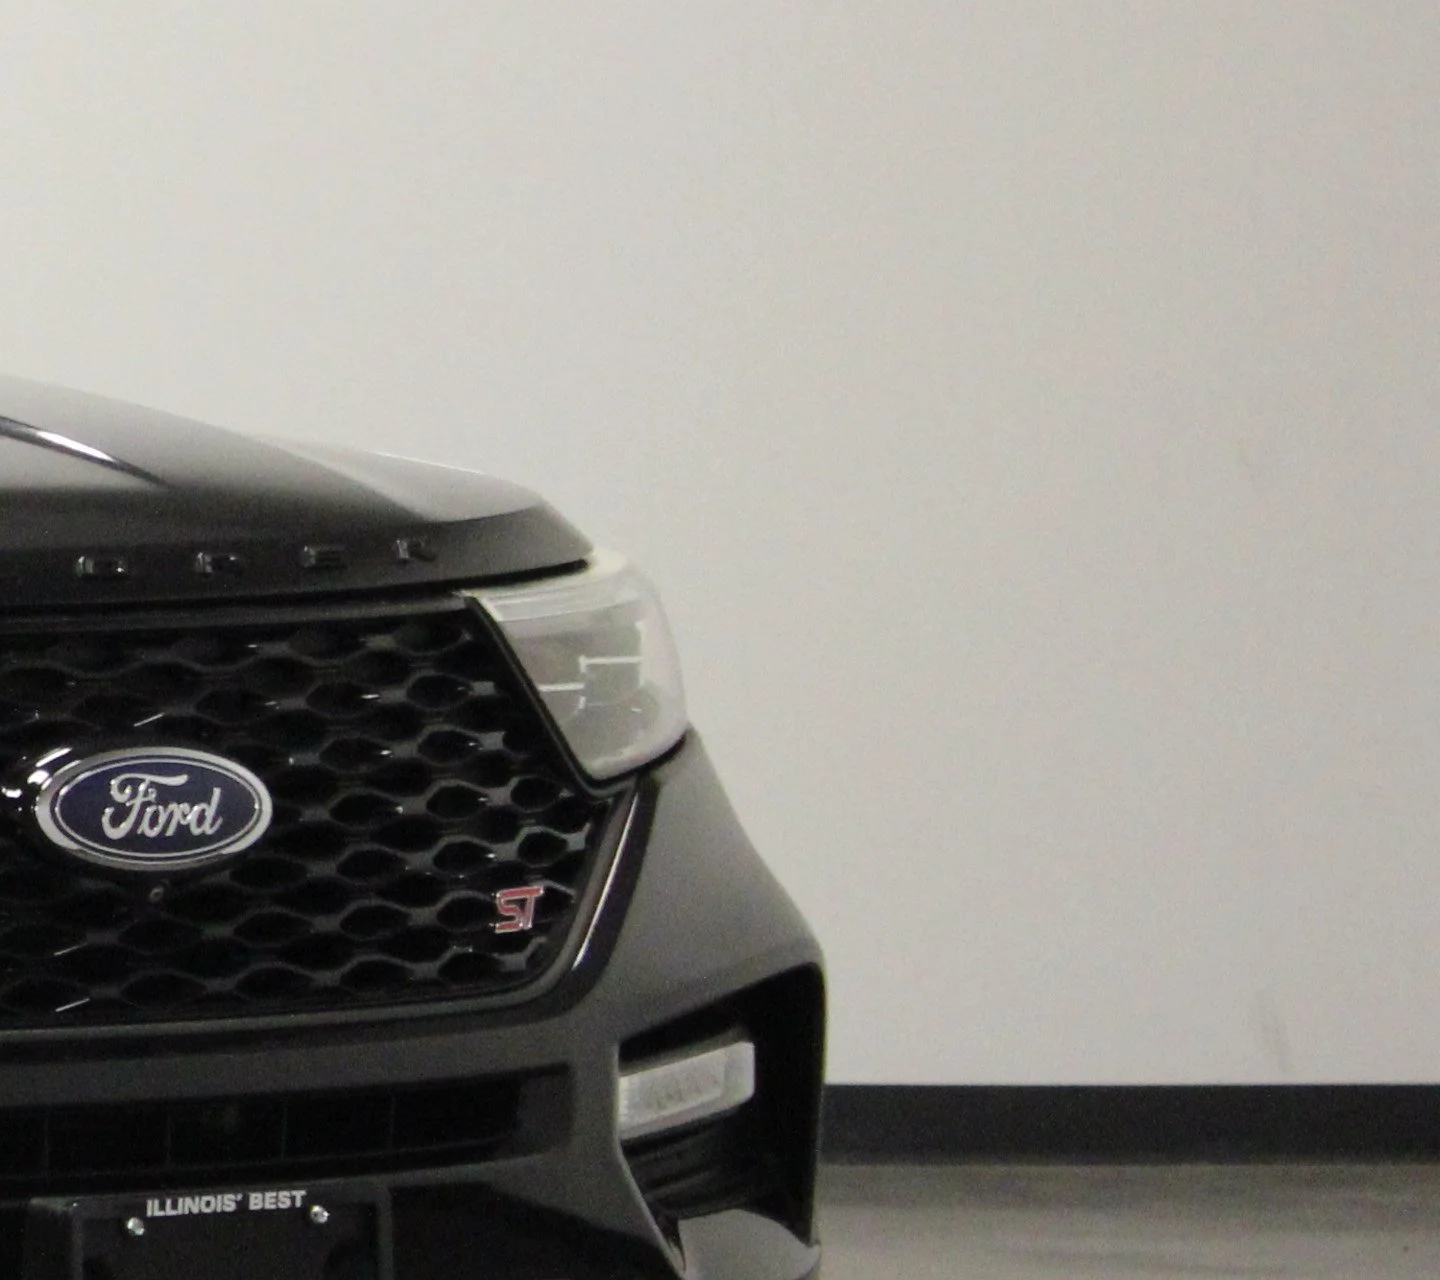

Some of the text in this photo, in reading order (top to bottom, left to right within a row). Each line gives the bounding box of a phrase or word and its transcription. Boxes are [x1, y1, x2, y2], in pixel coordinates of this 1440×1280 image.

[102, 772, 223, 840] Ford
[495, 886, 544, 933] ST
[146, 1189, 307, 1217] ILLINOIS' BEST
